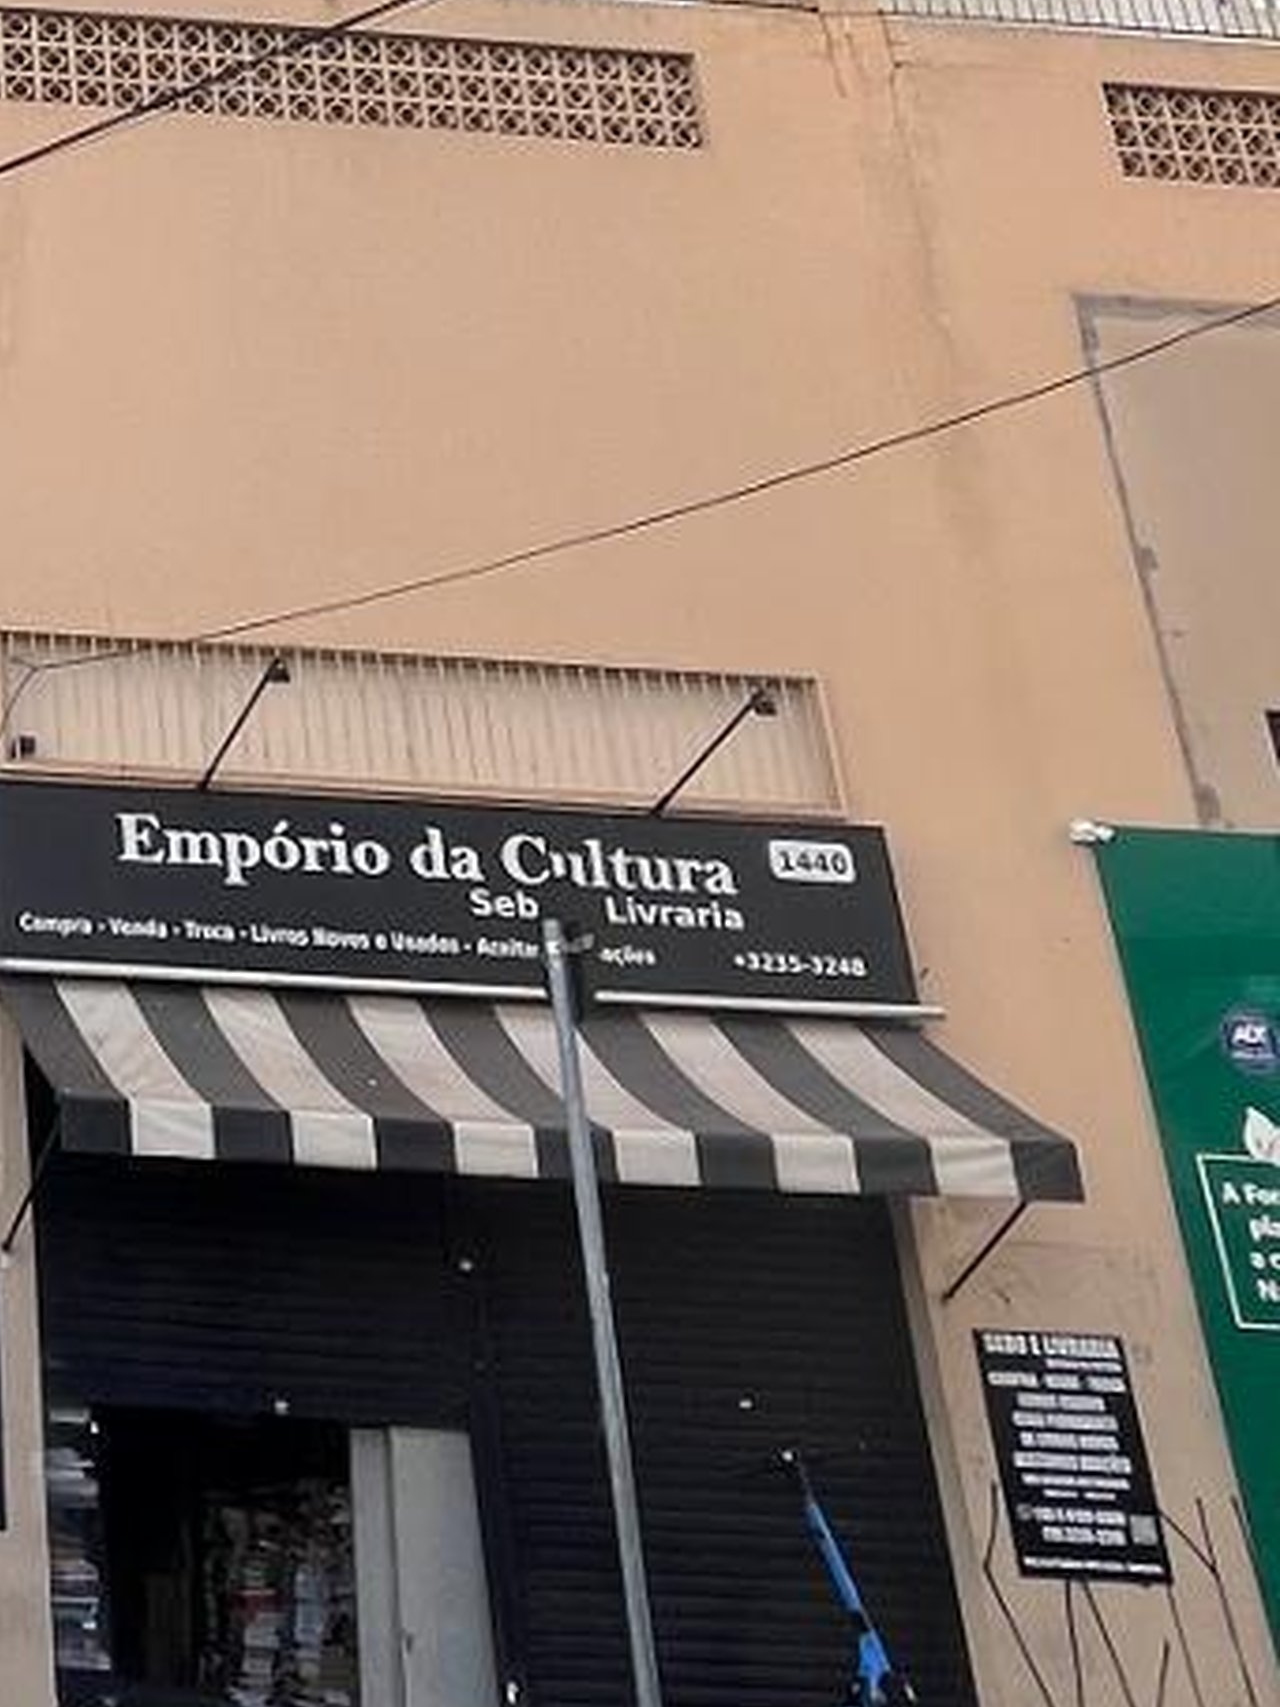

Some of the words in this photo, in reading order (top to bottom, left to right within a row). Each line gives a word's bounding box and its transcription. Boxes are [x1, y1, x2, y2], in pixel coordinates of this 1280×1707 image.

[115, 813, 391, 886] Empório
[409, 826, 484, 881] da
[500, 834, 739, 894] Cultura
[780, 850, 847, 875] 1440
[470, 888, 539, 920] Seb
[605, 896, 744, 929] Livraria
[20, 911, 92, 937] Compra
[108, 916, 168, 939] Venda
[184, 920, 236, 942] Troca
[250, 923, 310, 947] Livros
